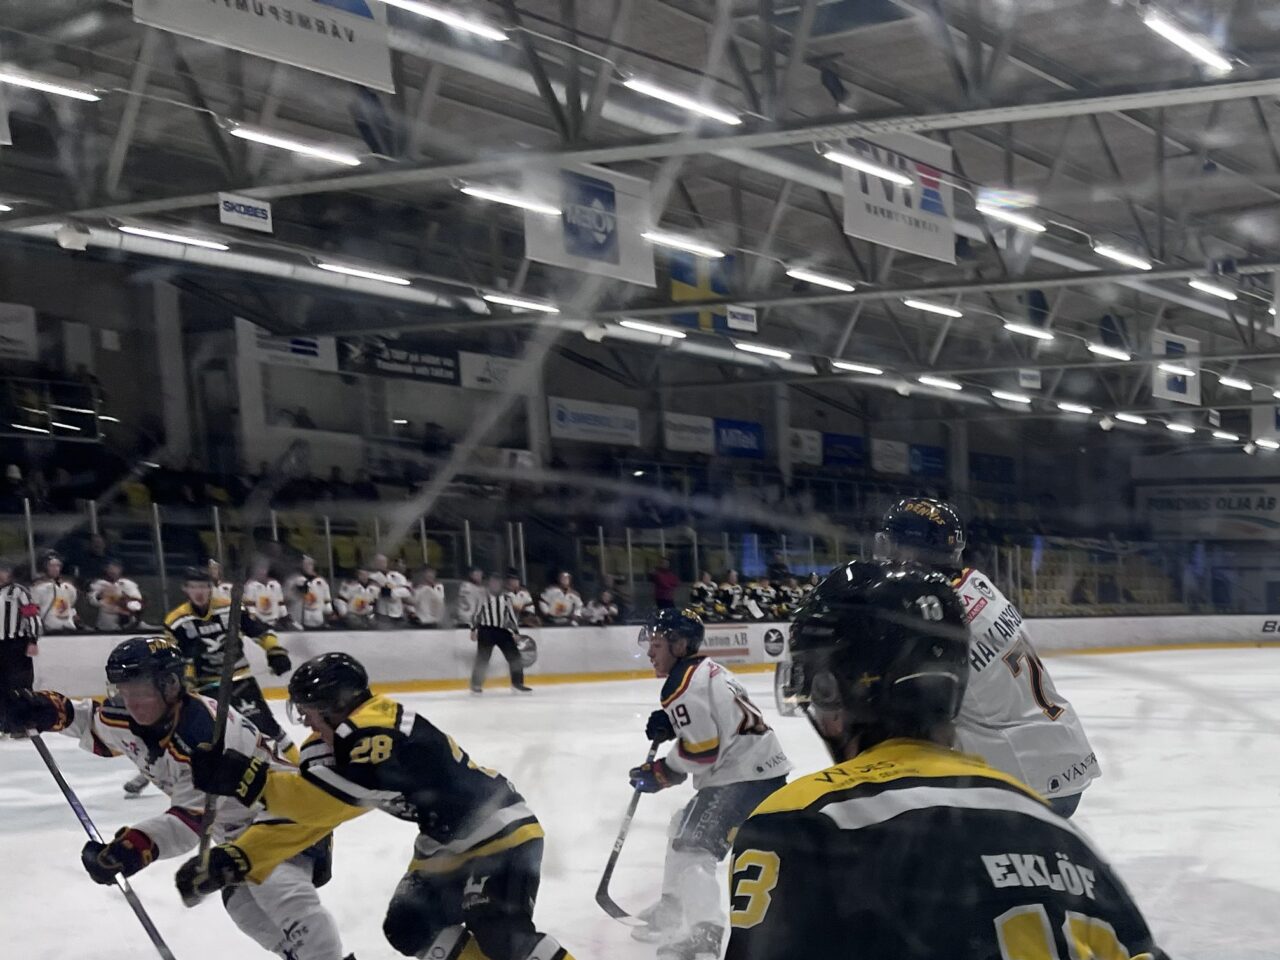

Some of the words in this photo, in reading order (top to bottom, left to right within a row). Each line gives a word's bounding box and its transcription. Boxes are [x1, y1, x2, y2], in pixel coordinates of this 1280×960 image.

[222, 200, 269, 220] SKOBES
[1255, 496, 1277, 511] AB
[350, 733, 394, 765] 28
[729, 849, 781, 929] 3
[981, 852, 1097, 901] EKLÖF
